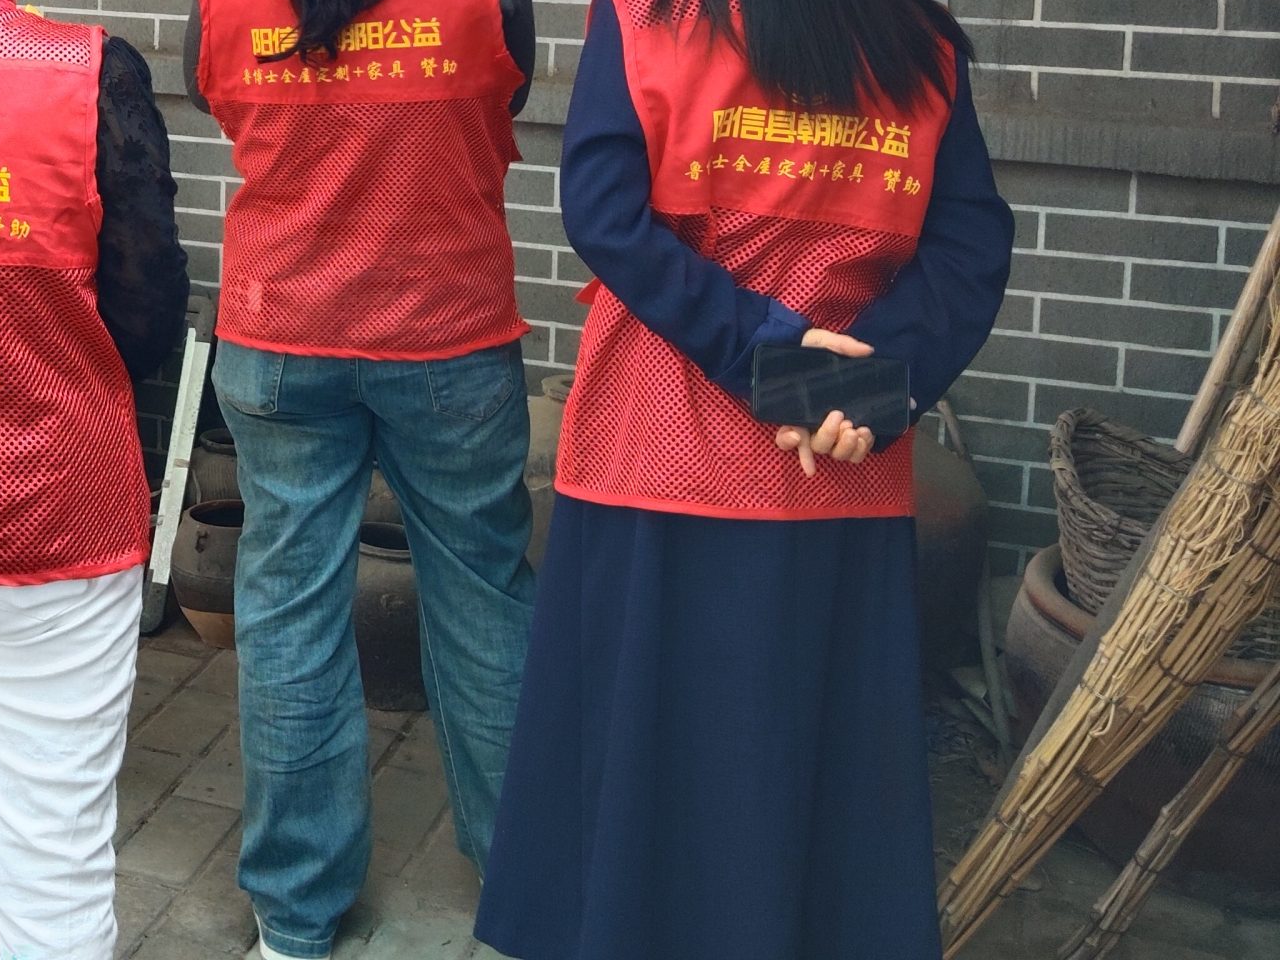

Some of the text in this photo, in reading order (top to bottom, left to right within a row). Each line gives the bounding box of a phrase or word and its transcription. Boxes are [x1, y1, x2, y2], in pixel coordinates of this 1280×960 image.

[713, 105, 911, 158] 阳信县朝阳公益
[684, 154, 865, 182] 鲁士全屋定制+家具
